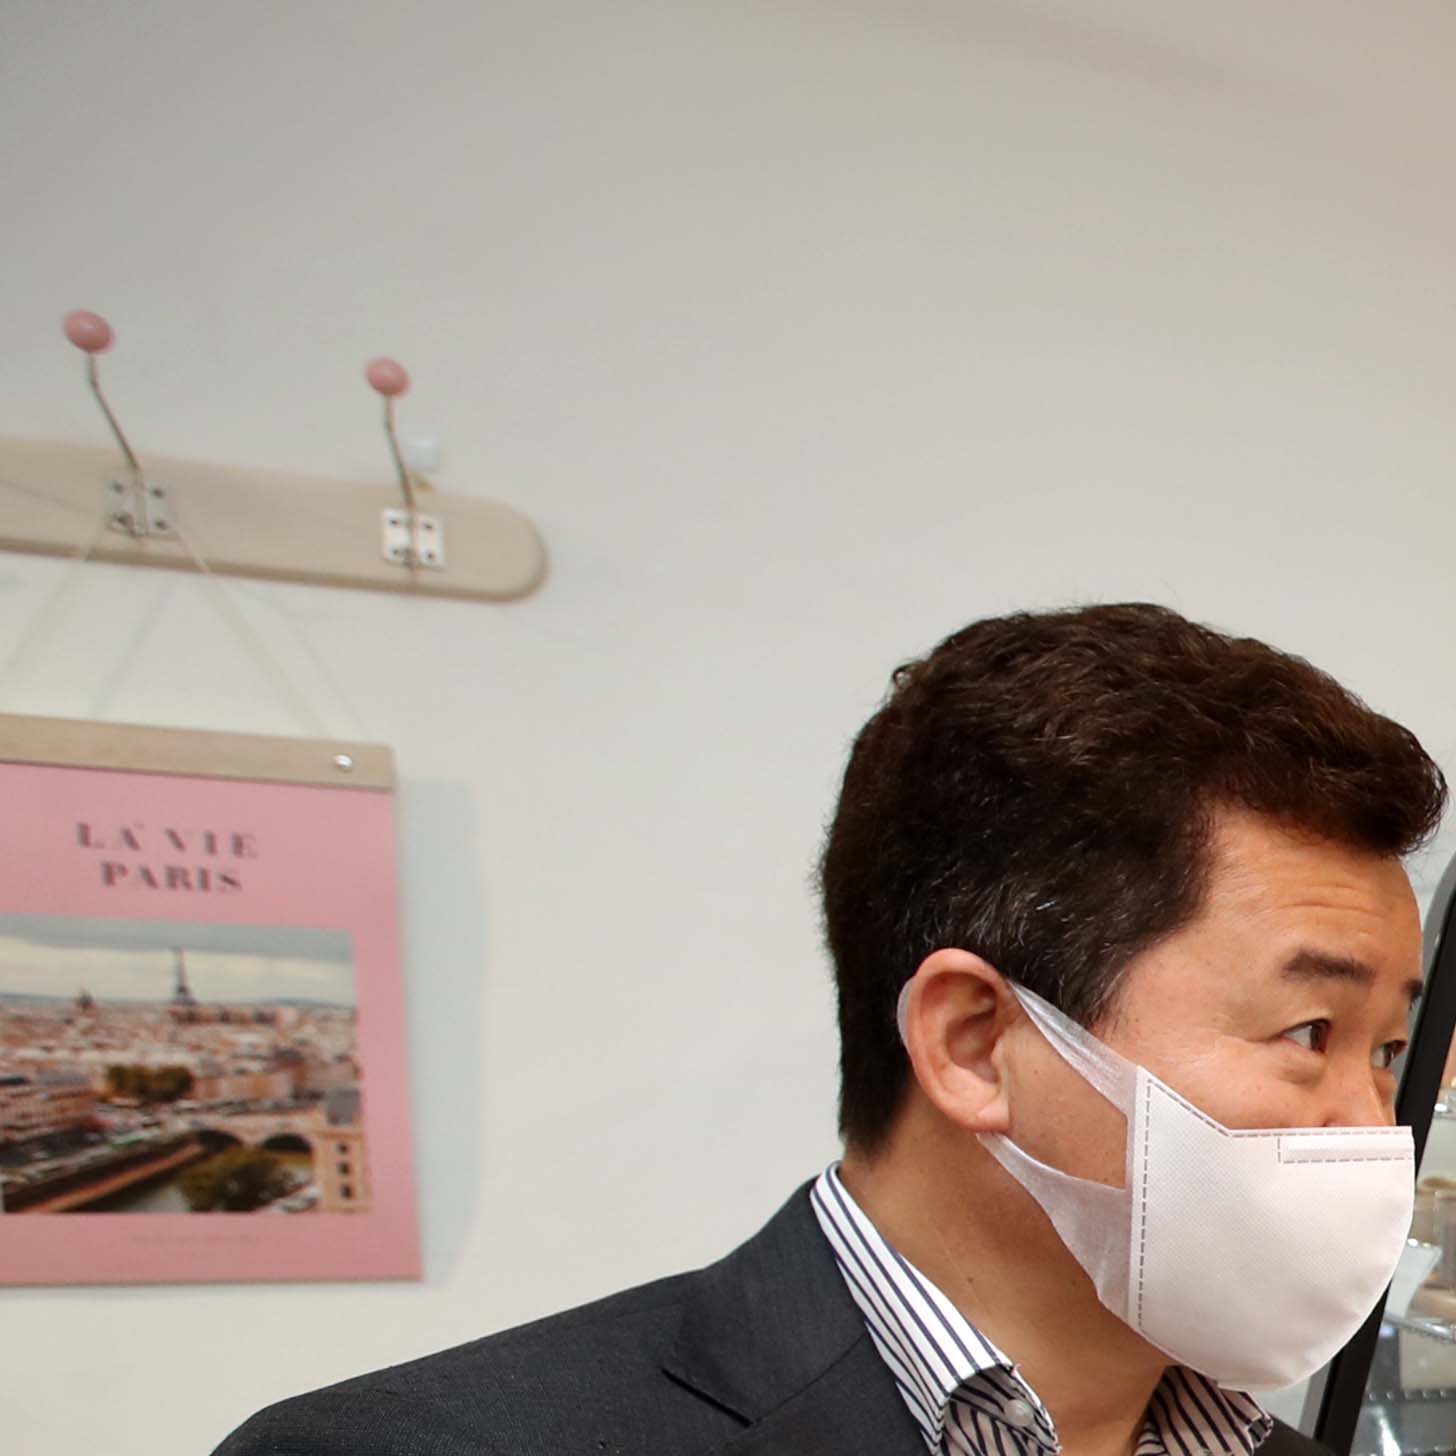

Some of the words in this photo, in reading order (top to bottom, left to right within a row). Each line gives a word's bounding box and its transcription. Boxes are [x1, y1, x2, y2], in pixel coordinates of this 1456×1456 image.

[77, 821, 142, 851] LA
[164, 827, 259, 857] VIE
[101, 860, 242, 892] PARIS
